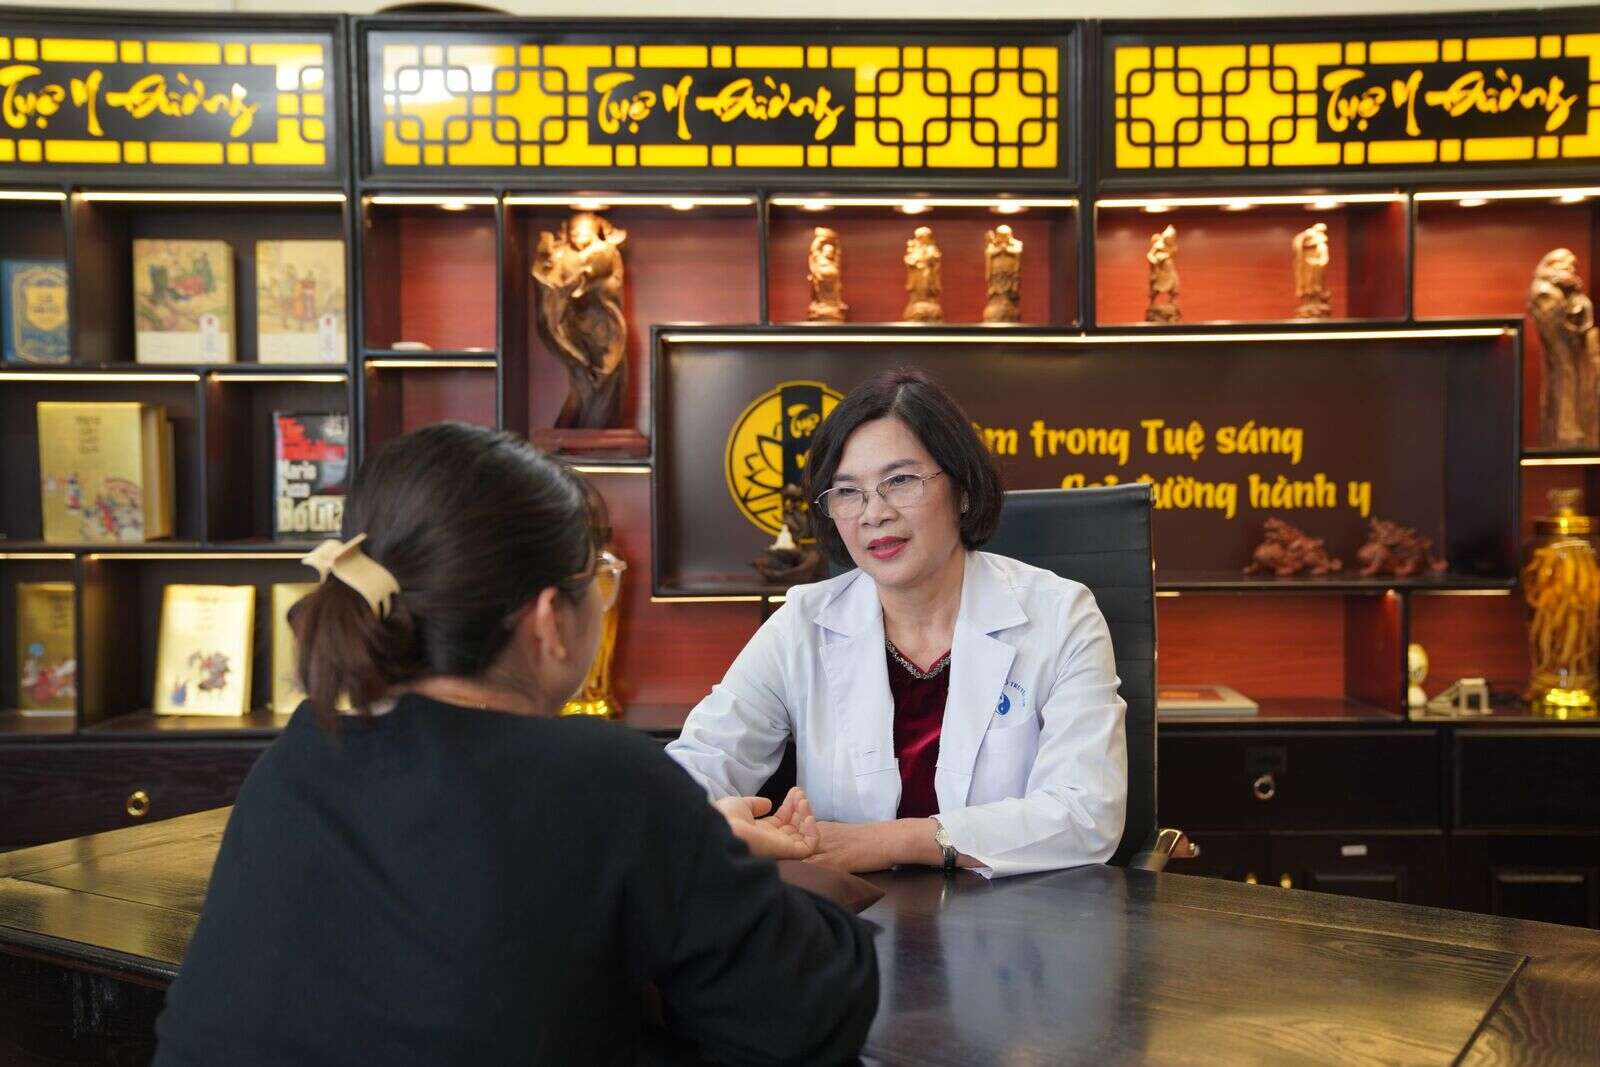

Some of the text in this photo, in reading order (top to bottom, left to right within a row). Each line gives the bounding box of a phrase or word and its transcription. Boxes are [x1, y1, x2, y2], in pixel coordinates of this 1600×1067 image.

[1030, 419, 1130, 466] trong
[1140, 419, 1205, 462] Tuệ
[1216, 419, 1304, 465] sáng
[1136, 473, 1238, 520] ường
[1248, 472, 1338, 509] hành
[1347, 481, 1371, 518] y
